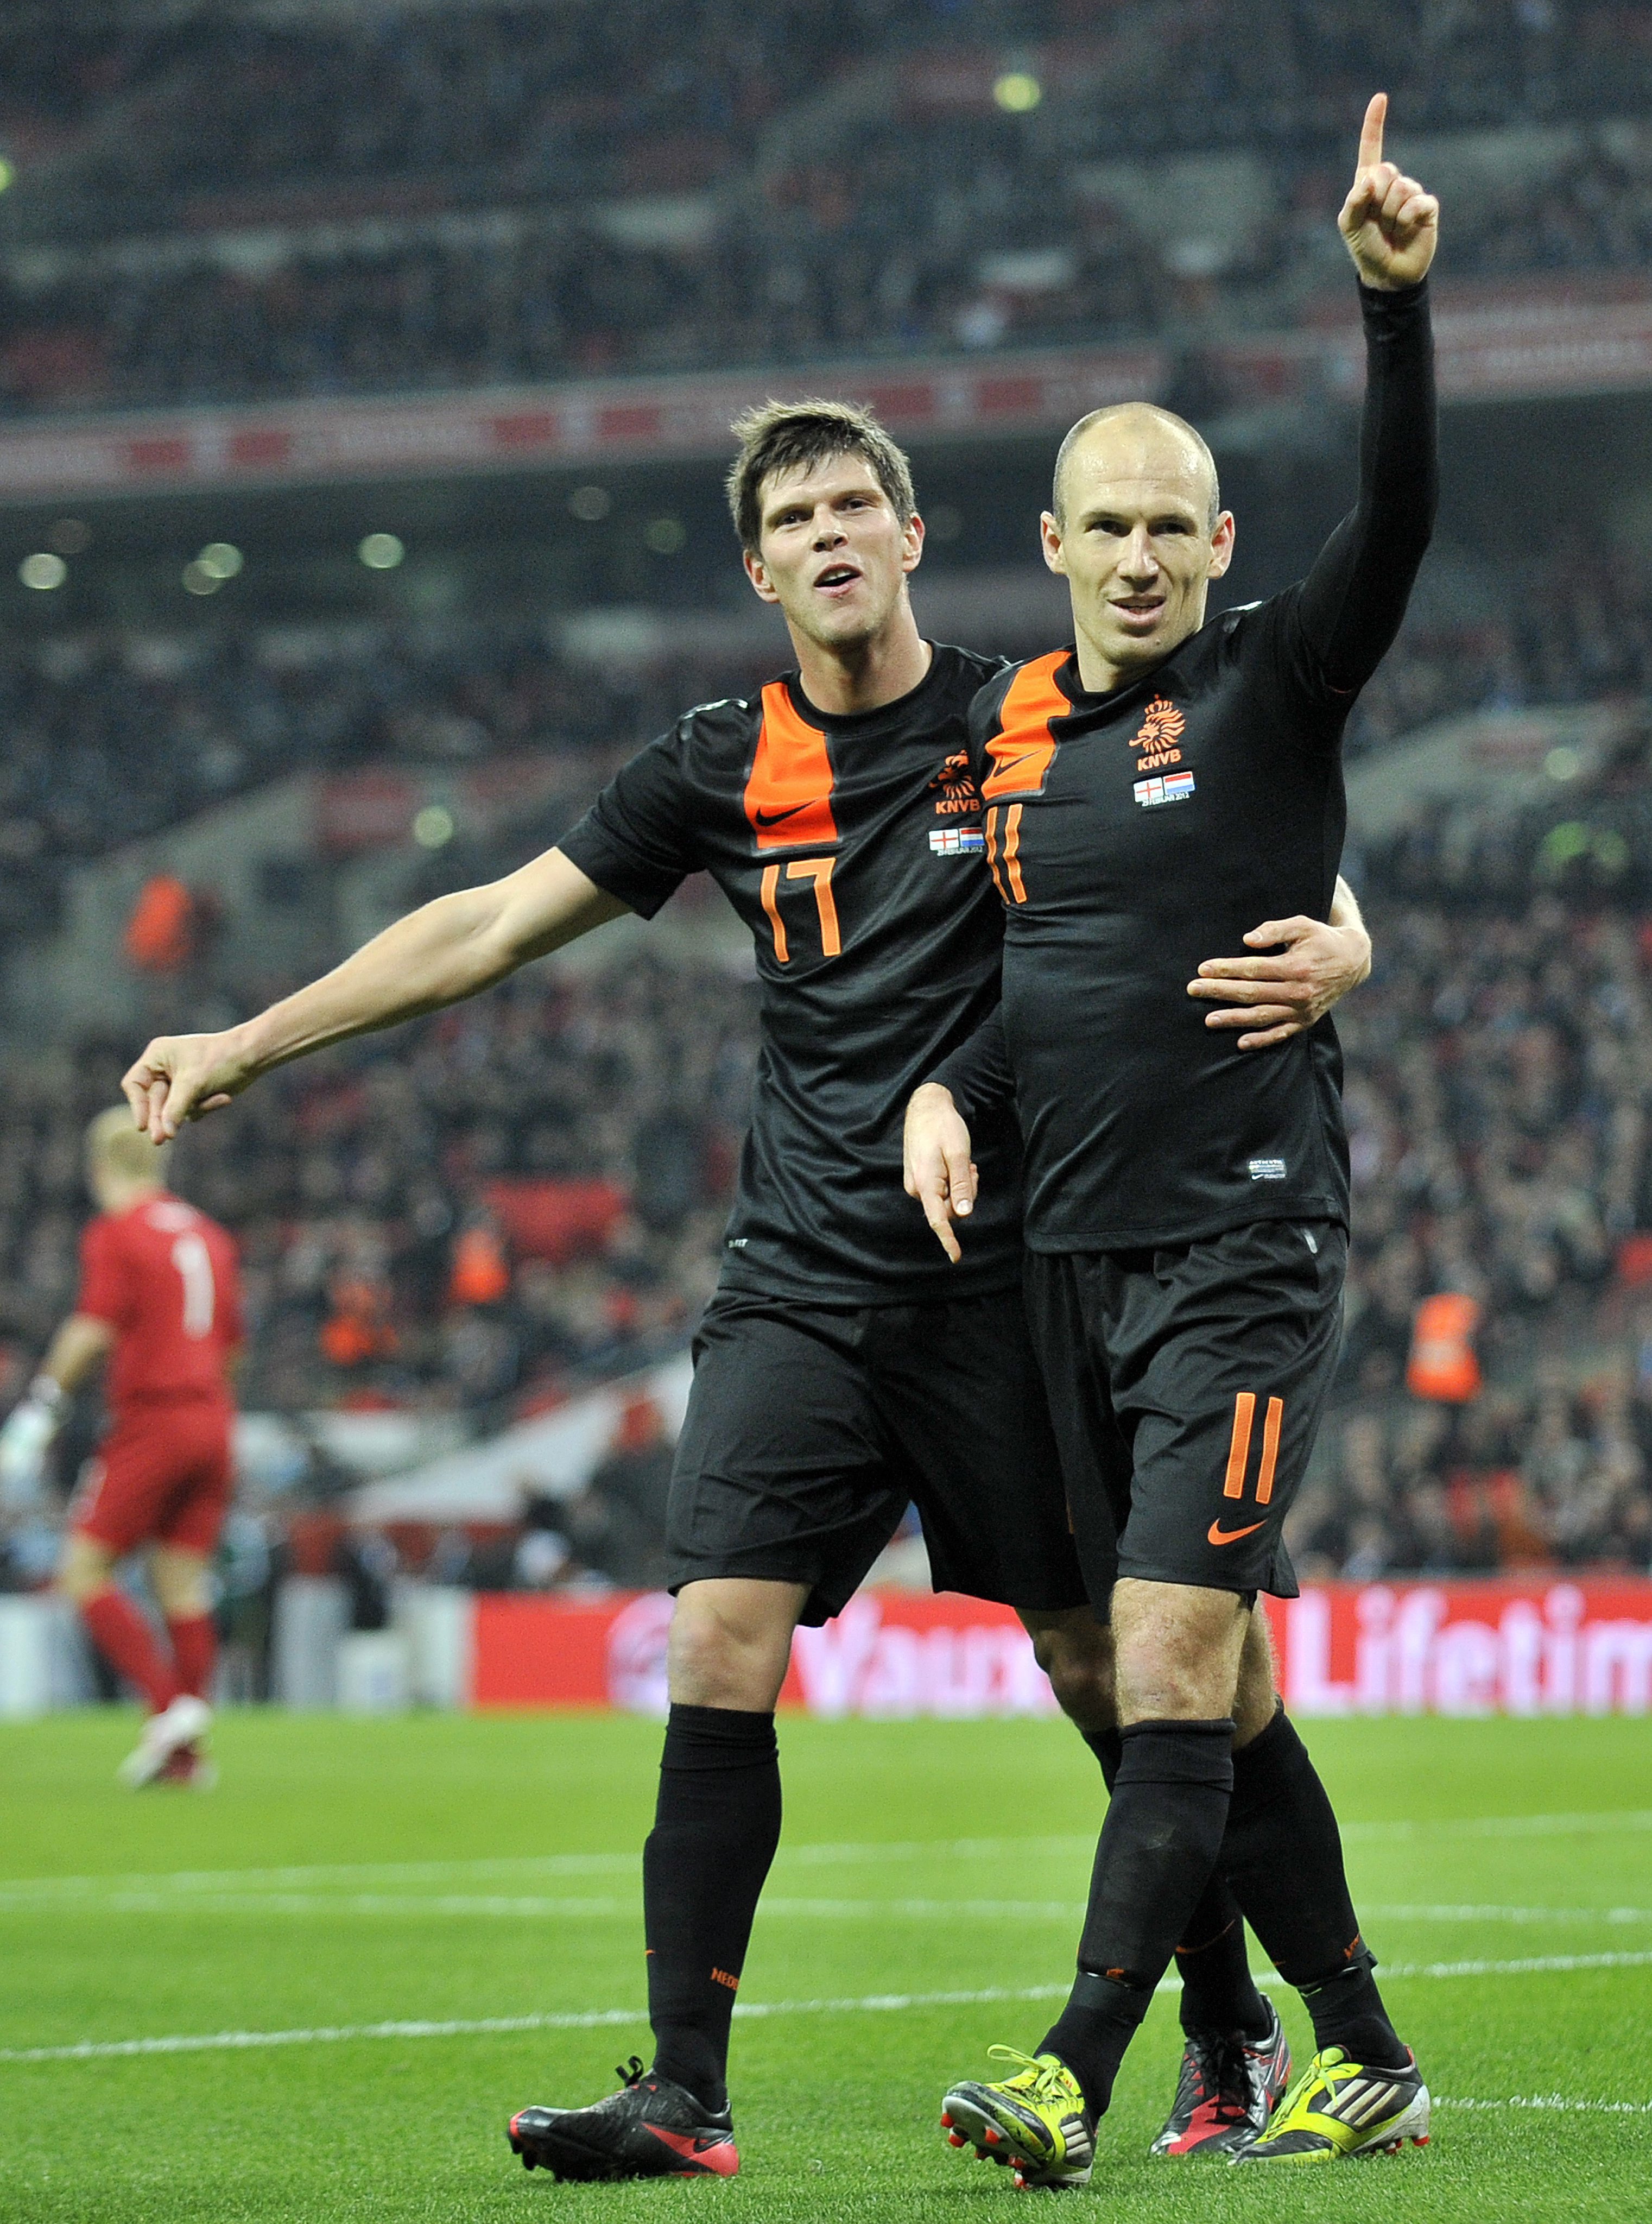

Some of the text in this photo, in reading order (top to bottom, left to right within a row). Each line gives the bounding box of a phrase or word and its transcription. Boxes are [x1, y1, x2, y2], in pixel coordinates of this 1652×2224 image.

[936, 799, 980, 814] KNVB
[1137, 749, 1181, 771] KNVB
[985, 804, 1028, 905] 11
[761, 857, 841, 963] 17
[171, 1234, 215, 1340] 1
[1223, 1392, 1283, 1505] 11
